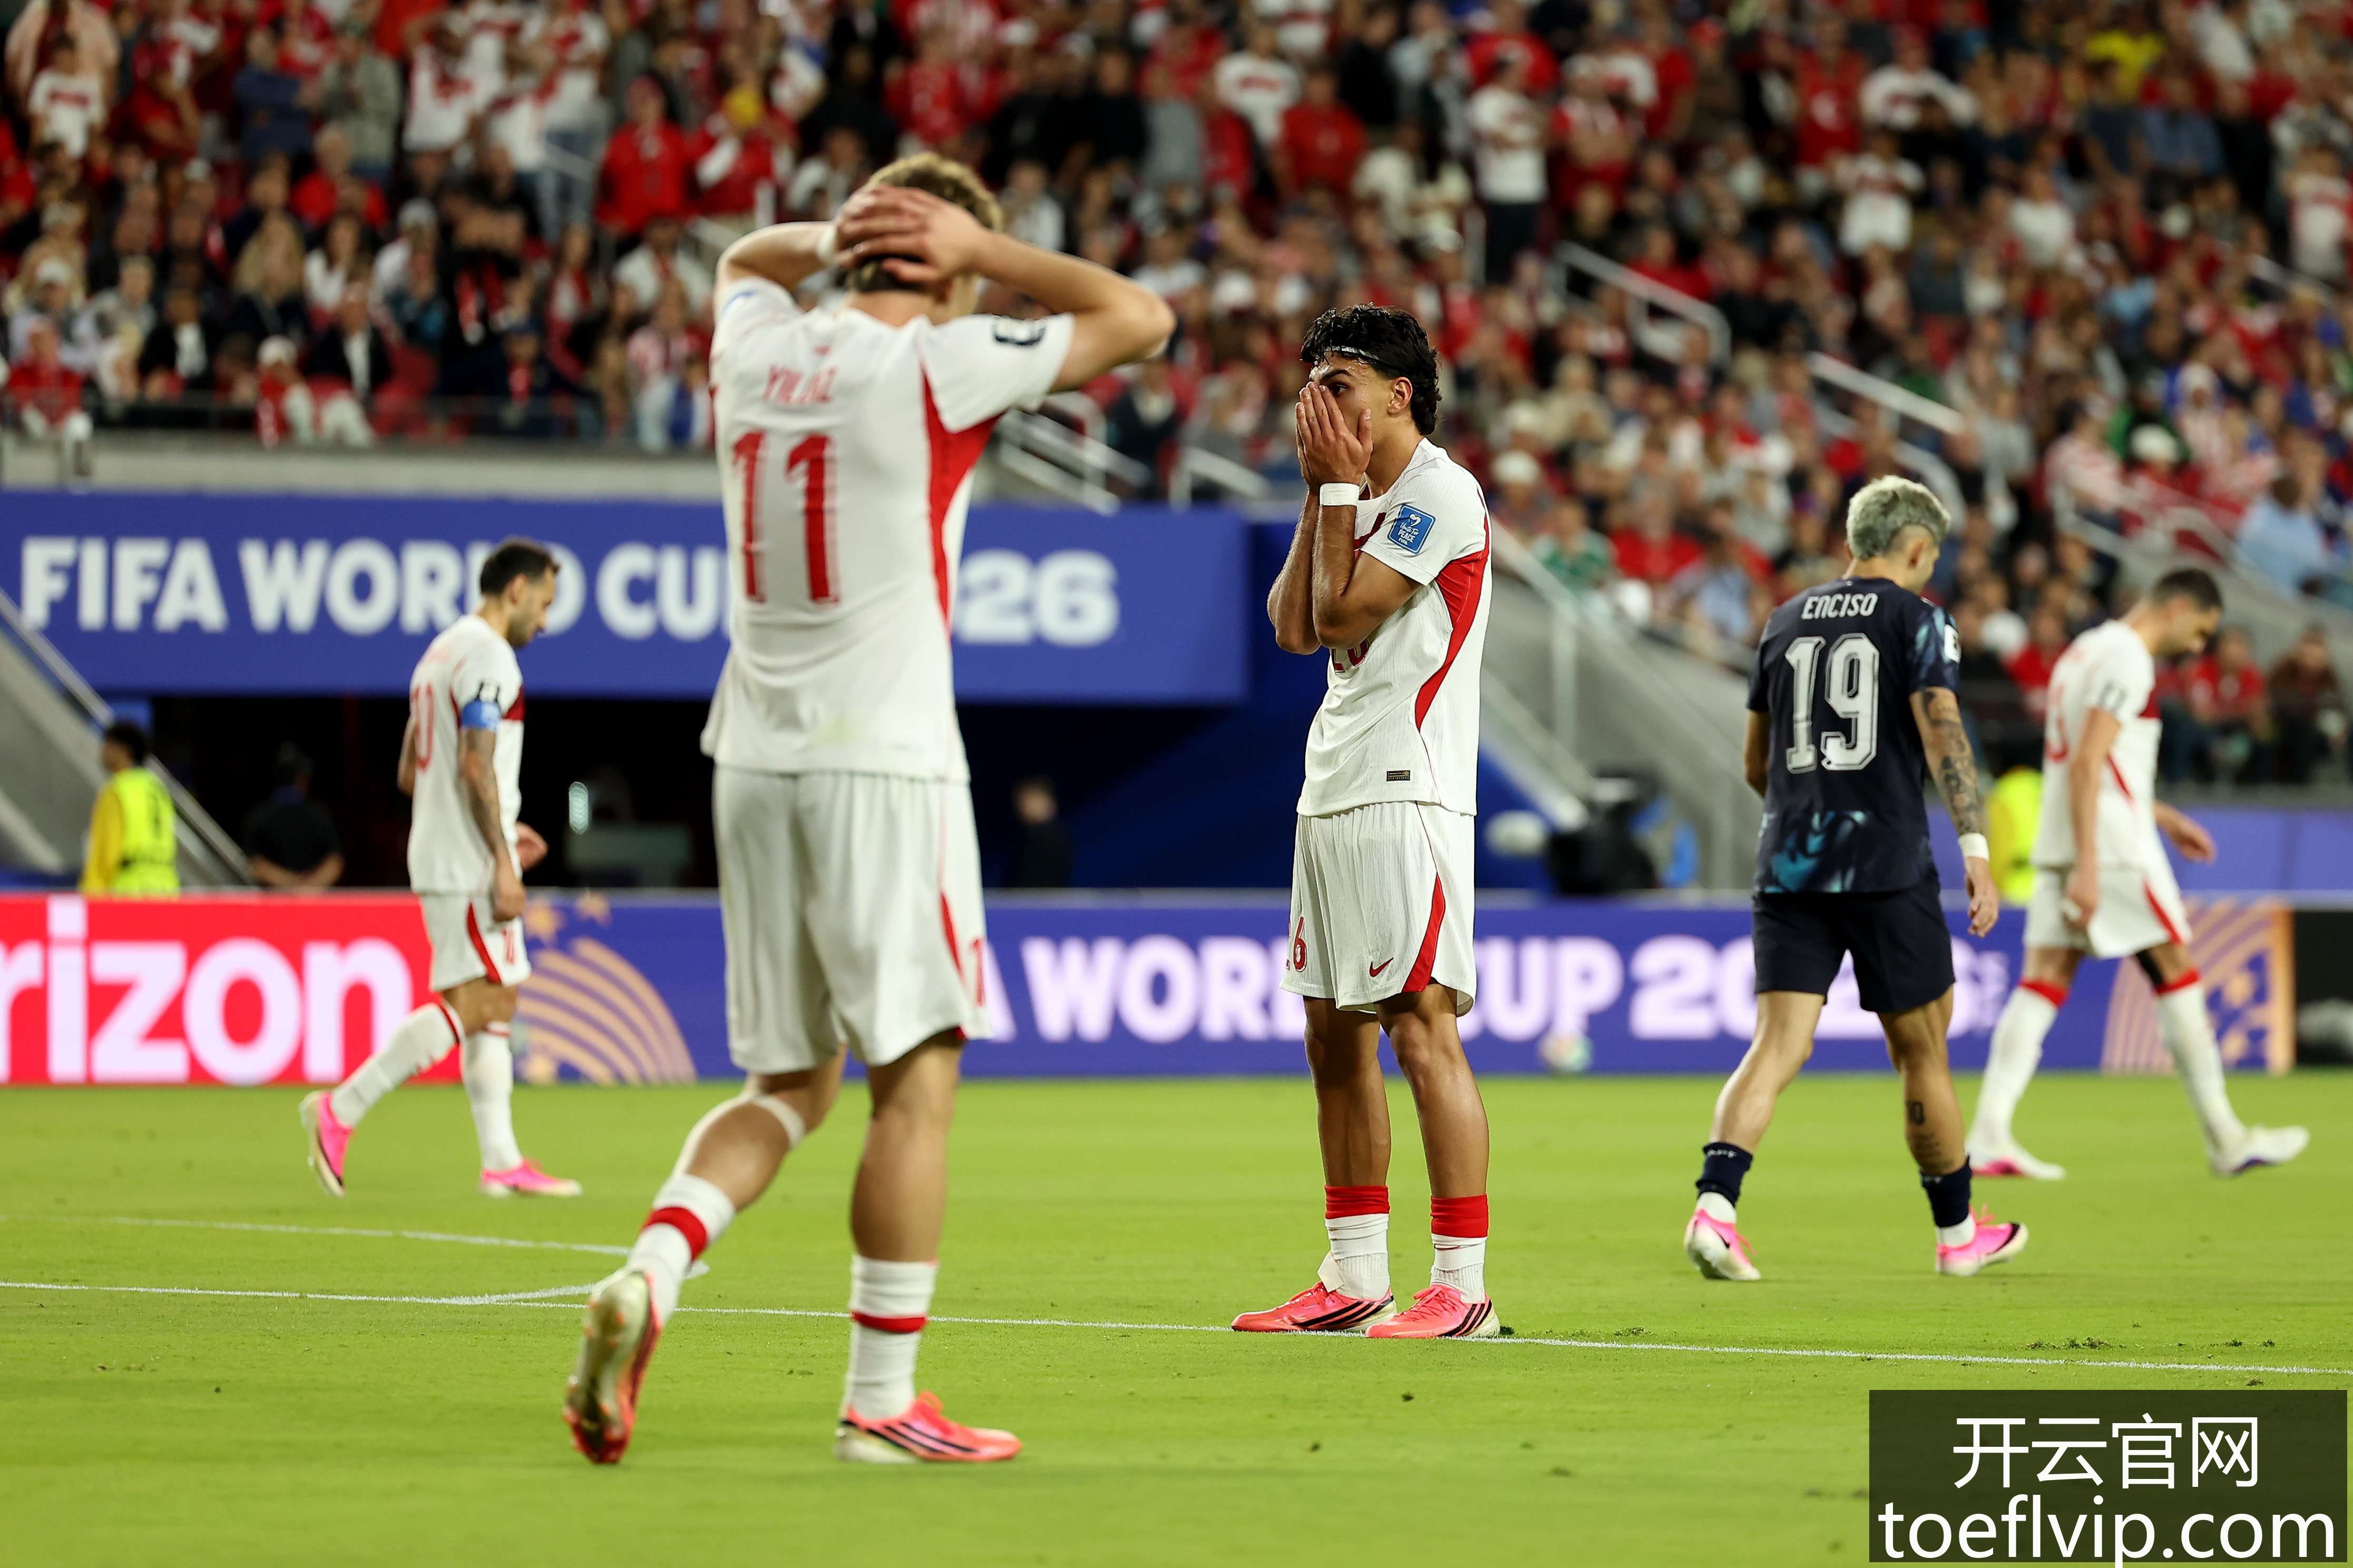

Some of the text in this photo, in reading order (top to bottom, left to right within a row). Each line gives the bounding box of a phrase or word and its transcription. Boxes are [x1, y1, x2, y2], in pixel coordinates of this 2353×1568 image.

[733, 429, 839, 604] 11
[1398, 529, 1416, 543] PEACE
[22, 536, 229, 632] FIFA
[595, 543, 731, 642] CU
[953, 550, 1119, 648] 26
[1801, 592, 1879, 620] ENCISO
[1785, 632, 1880, 774] 19
[1019, 934, 1306, 1043] WOR
[1458, 936, 1624, 1043] UP
